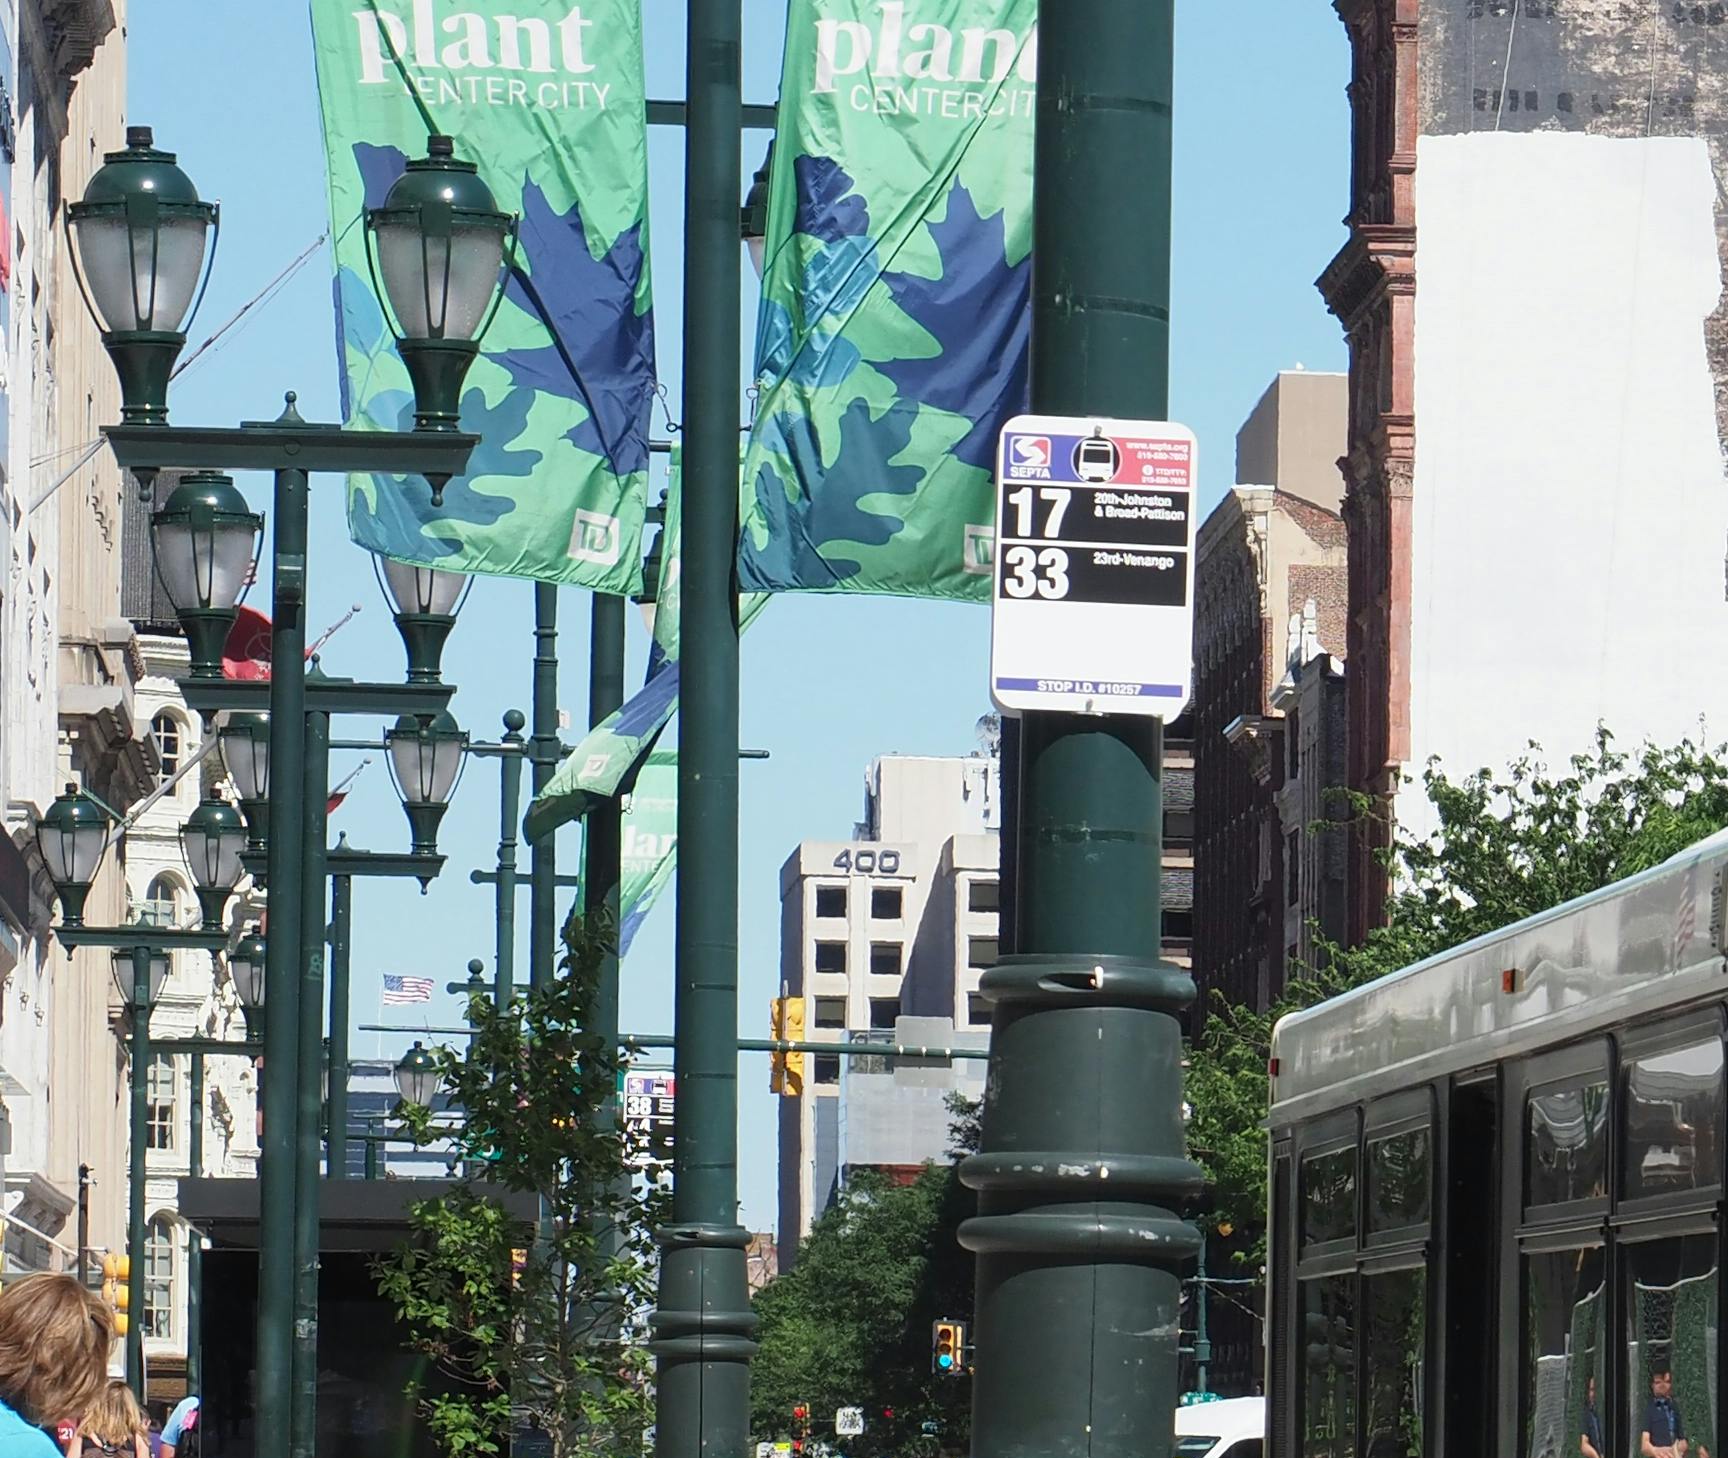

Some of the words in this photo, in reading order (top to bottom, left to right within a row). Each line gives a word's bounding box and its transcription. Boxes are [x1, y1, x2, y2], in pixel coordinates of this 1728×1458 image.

[352, 0, 596, 84] plant
[811, 0, 1037, 94] plan
[538, 82, 611, 111] CITY
[850, 85, 986, 119] CENTER
[987, 90, 1037, 118] CIT
[1010, 466, 1051, 479] SEPTA
[1008, 486, 1072, 538] 17
[1094, 491, 1172, 507] 20th-Johnston
[578, 519, 613, 552] TD
[1004, 546, 1070, 600] 33
[1093, 552, 1175, 570] 23rd-Venango
[1037, 680, 1073, 692] STOP
[1098, 683, 1142, 695] #10257
[832, 848, 901, 874] 400
[627, 1096, 652, 1115] 38
